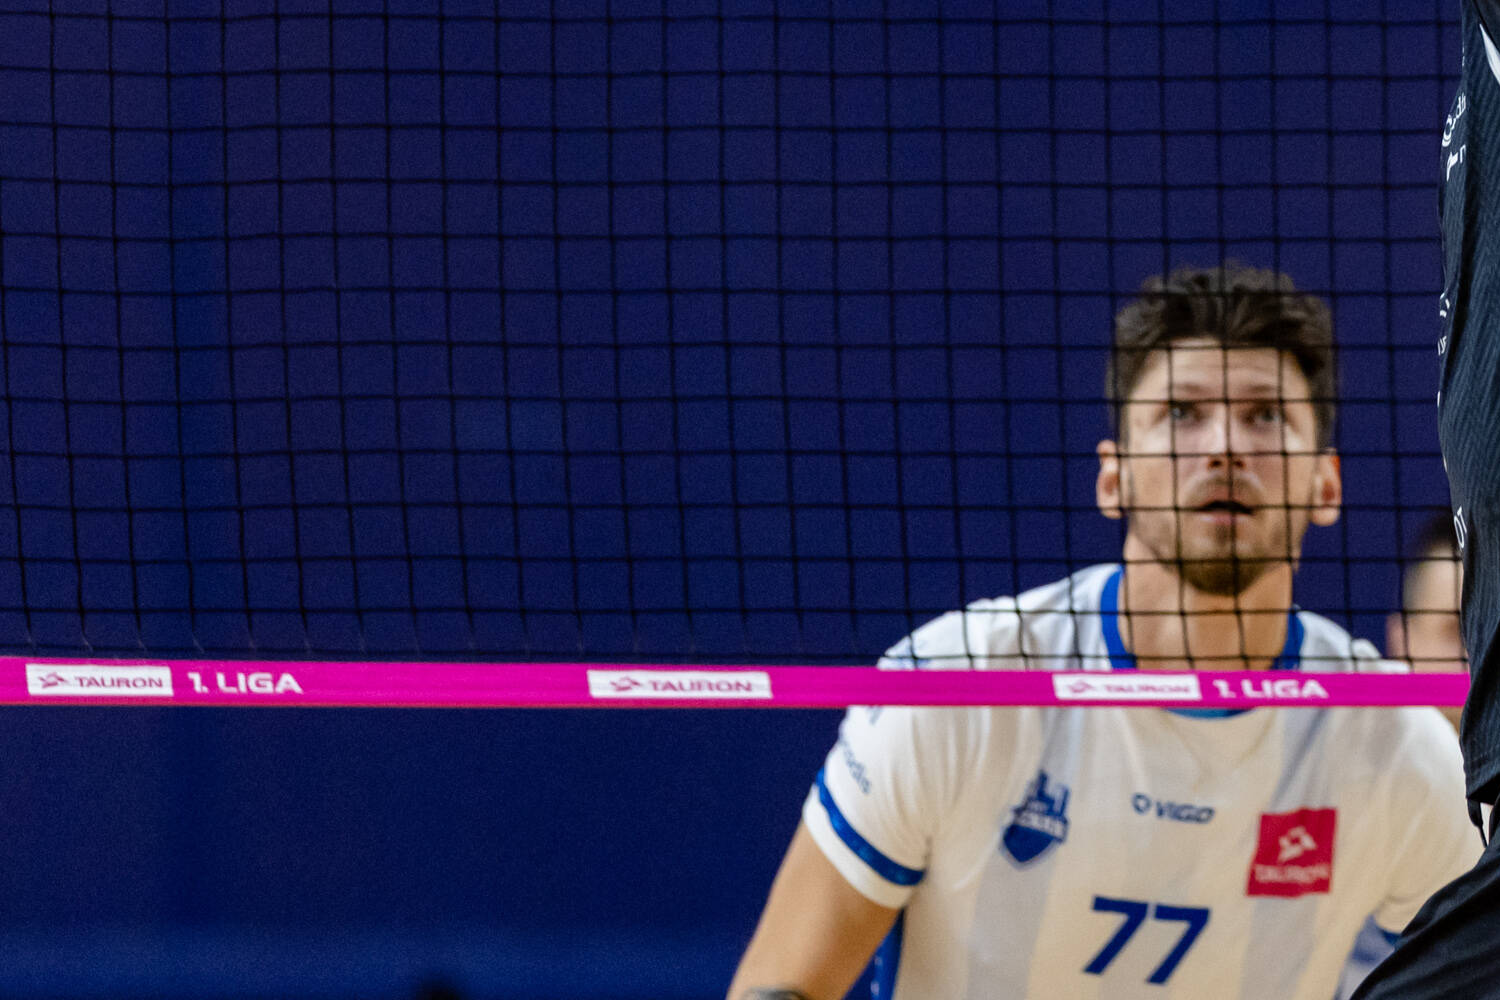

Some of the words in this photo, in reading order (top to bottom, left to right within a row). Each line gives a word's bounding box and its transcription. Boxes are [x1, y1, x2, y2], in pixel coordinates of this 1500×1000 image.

[74, 674, 163, 690] TAURON
[188, 672, 208, 694] 1.
[217, 672, 303, 695] LIGA
[648, 677, 753, 694] TAURON
[1213, 679, 1236, 699] 1.
[1243, 679, 1327, 699] LIGA
[1155, 799, 1214, 825] VIGO
[1084, 896, 1210, 985] 77
